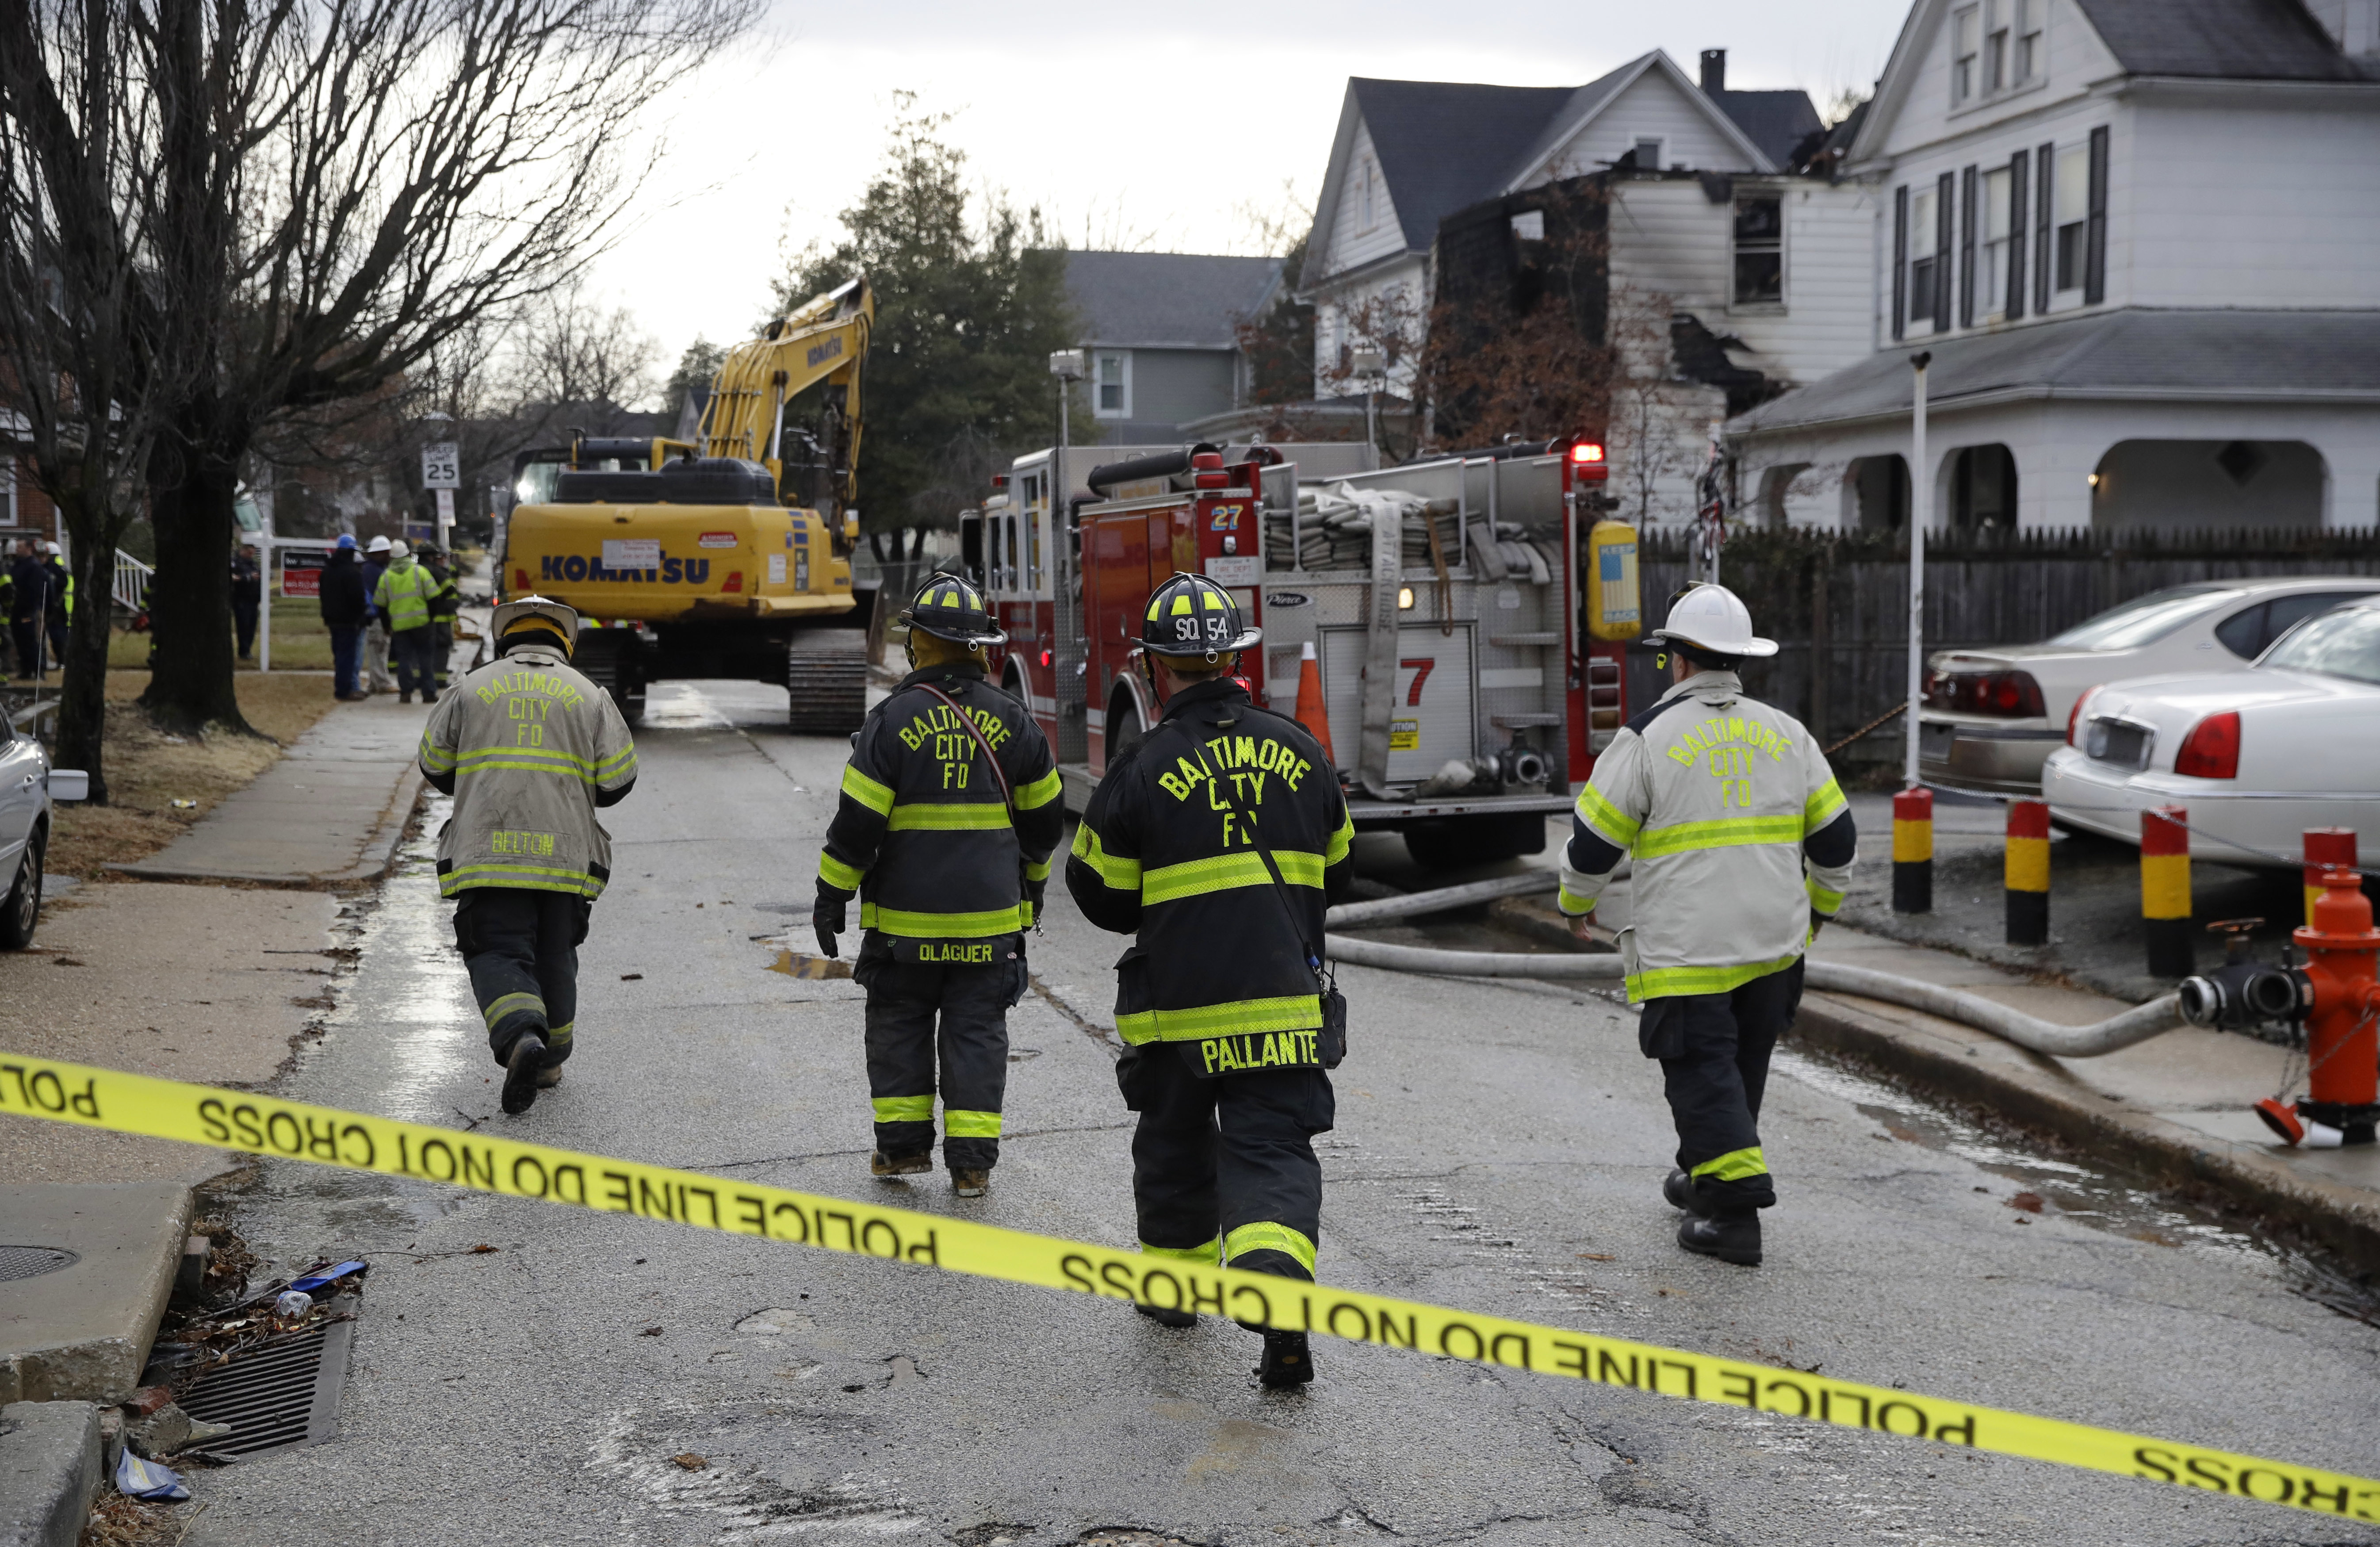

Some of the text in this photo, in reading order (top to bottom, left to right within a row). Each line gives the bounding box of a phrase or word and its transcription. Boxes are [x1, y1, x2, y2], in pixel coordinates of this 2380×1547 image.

[428, 464, 455, 479] 25
[1211, 504, 1244, 531] 27
[1267, 594, 1302, 605] Pierce
[1176, 617, 1228, 641] SQ 54
[476, 672, 584, 712] BALTIMORE
[509, 697, 551, 721] CITY
[517, 724, 543, 747] FD
[1391, 722, 1417, 732] UTION
[936, 734, 977, 761] CITY
[1666, 717, 1793, 768] BALTIMORE
[943, 762, 969, 789] FD
[1709, 747, 1754, 777] CITY
[1208, 771, 1266, 810] CTY
[1722, 780, 1751, 808] FD
[492, 831, 555, 857] BELTON
[919, 943, 993, 963] OLAGUER
[1201, 1030, 1319, 1073] PALLANTE
[0, 1064, 101, 1120] POL
[198, 1098, 939, 1265] POLICE LINE DO NOT CROSS
[1061, 1254, 1271, 1325] CROSS
[1439, 1322, 1531, 1369] DO
[1553, 1340, 1696, 1400] LINE
[1720, 1369, 1975, 1446] POLICE
